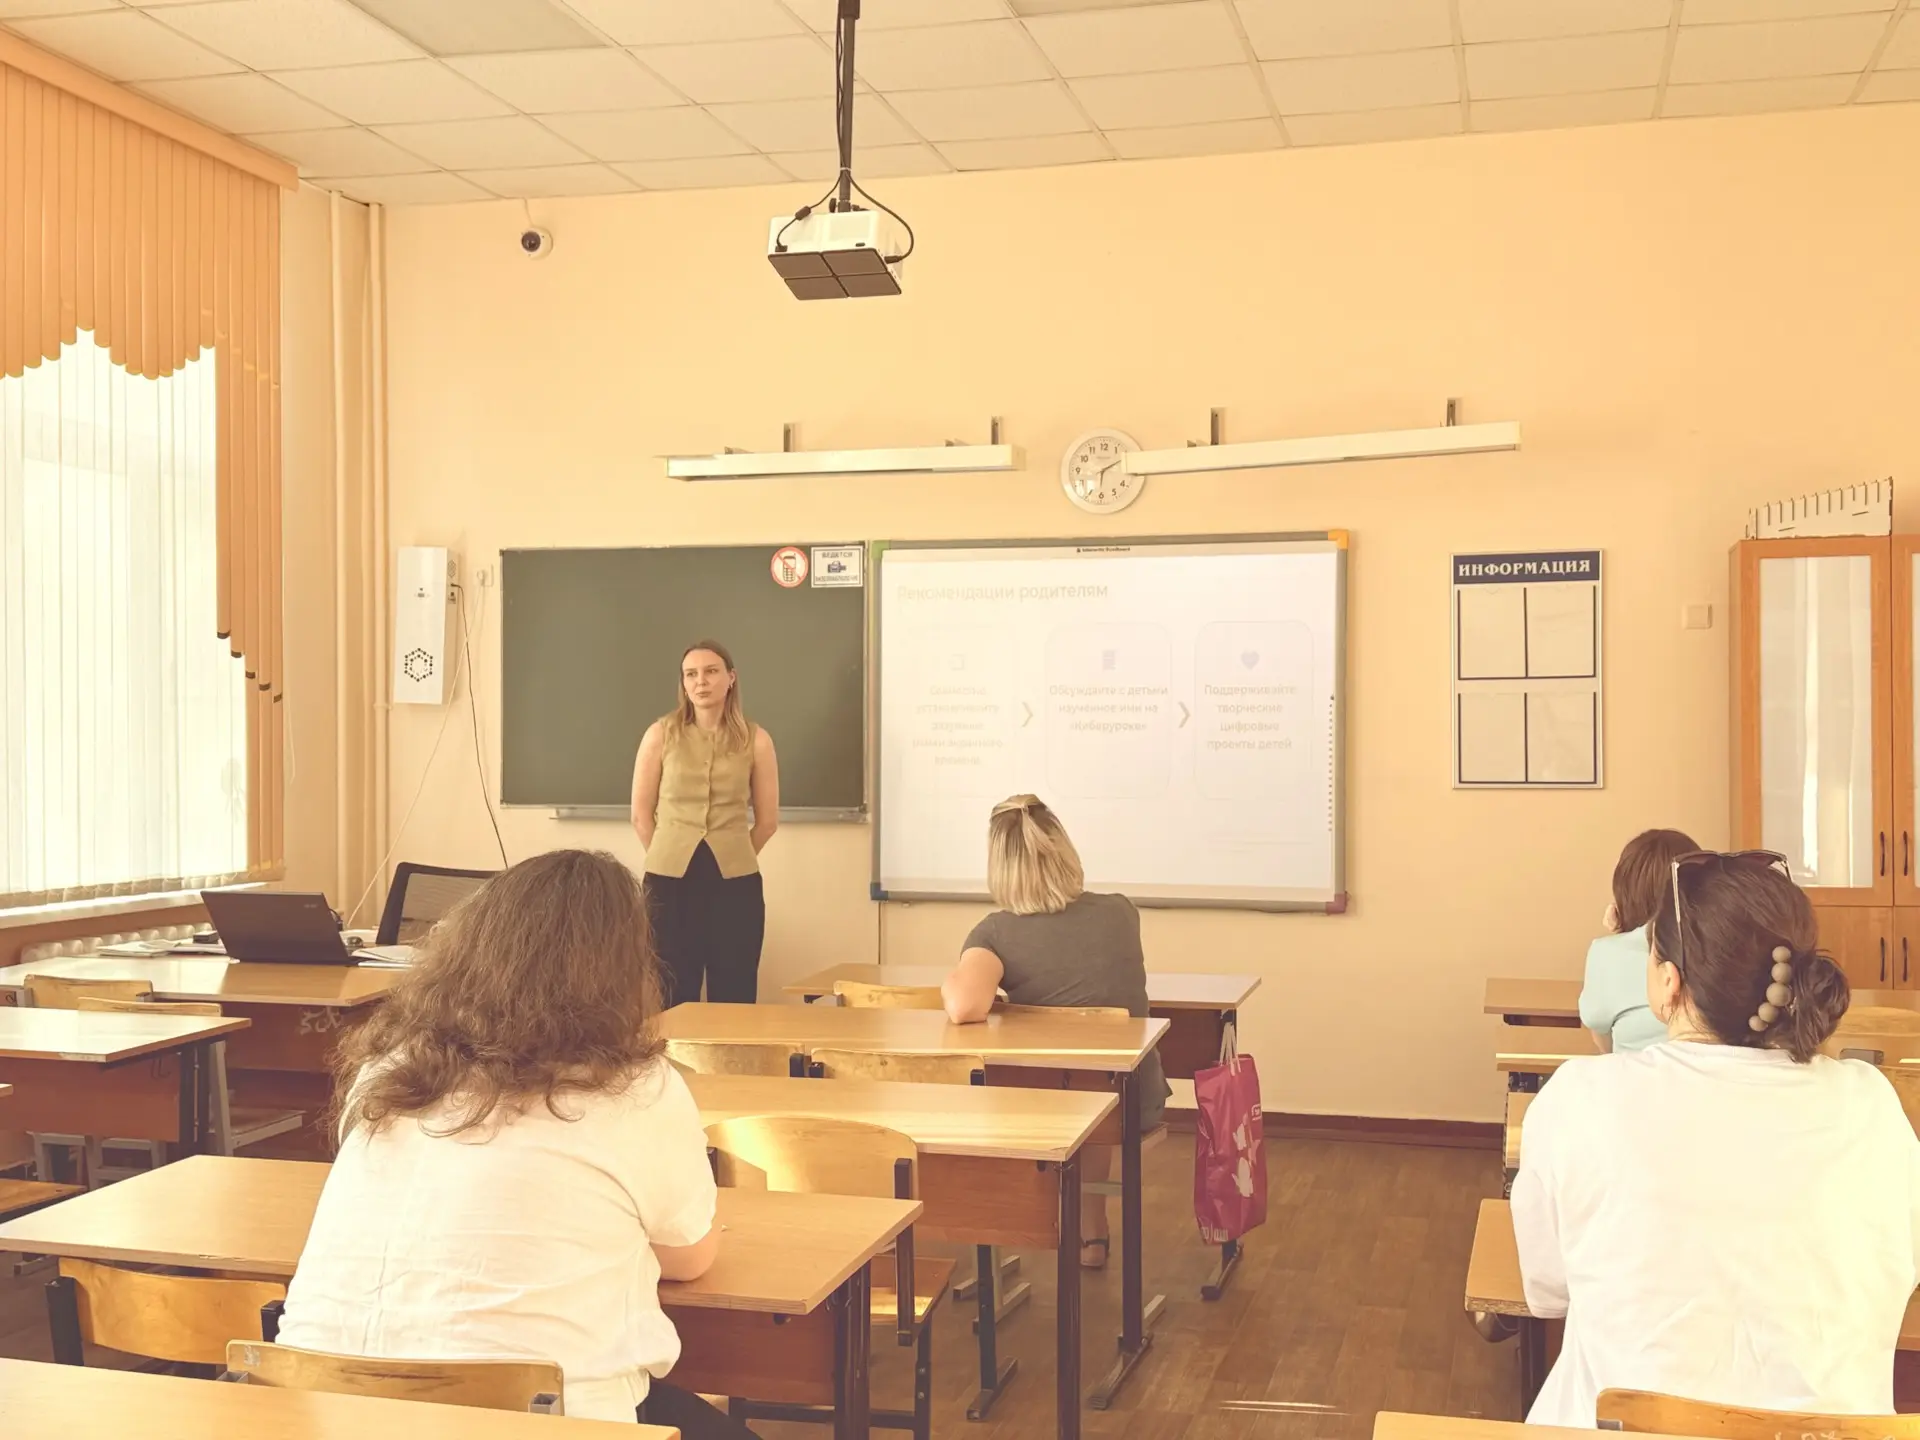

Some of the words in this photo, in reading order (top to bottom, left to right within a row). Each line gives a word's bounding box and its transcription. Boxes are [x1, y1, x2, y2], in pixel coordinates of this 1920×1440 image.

[1089, 446, 1096, 455] 11
[1100, 442, 1109, 451] 12
[1114, 446, 1118, 454] 1
[1080, 454, 1089, 463] 10
[1075, 467, 1081, 475] 9
[1119, 480, 1126, 488] 4
[1098, 491, 1105, 500] 6
[1111, 488, 1117, 496] 5
[1458, 559, 1591, 577] ИНФОРМАЦИЯ
[897, 586, 1015, 602] Рекомендации
[1019, 584, 1109, 602] родителям
[1127, 686, 1169, 698] детьми
[1204, 683, 1298, 697] Поддерживайте
[1058, 703, 1119, 715] изученное
[1145, 703, 1159, 713] на
[1216, 703, 1284, 716] творческие
[1220, 720, 1280, 733] цифровые
[1206, 739, 1255, 751] проекты
[1258, 736, 1292, 750] детей
